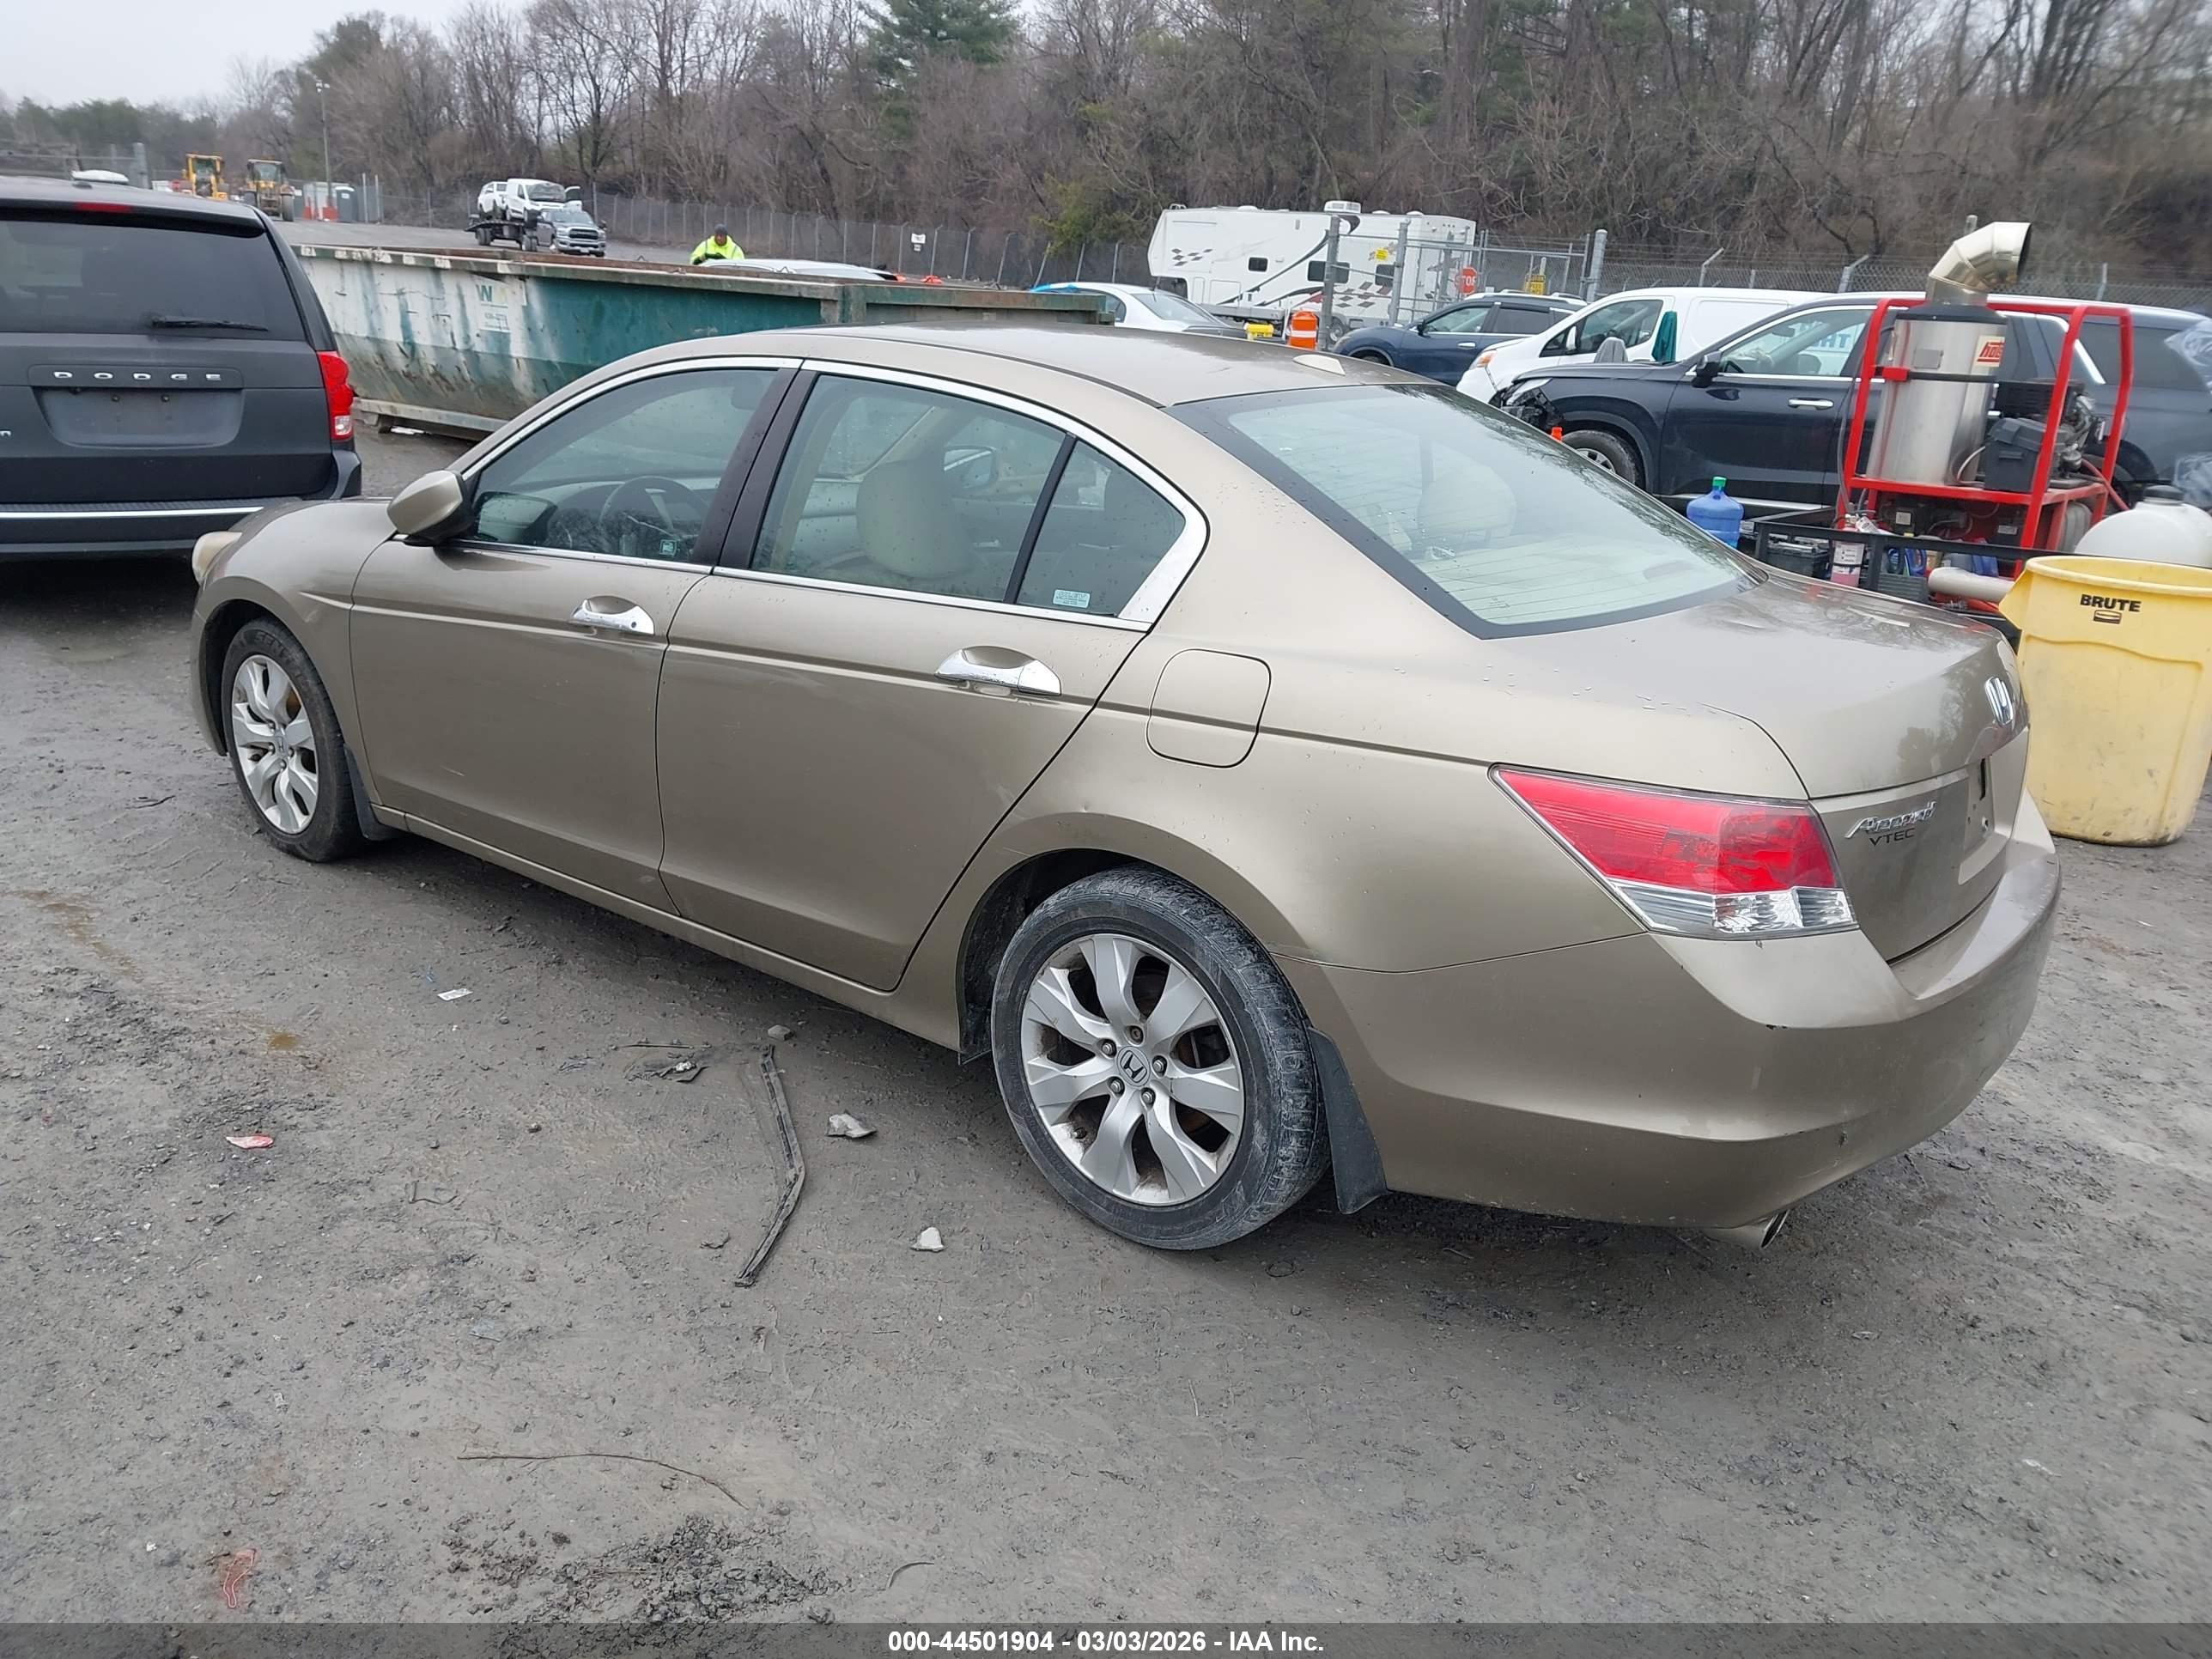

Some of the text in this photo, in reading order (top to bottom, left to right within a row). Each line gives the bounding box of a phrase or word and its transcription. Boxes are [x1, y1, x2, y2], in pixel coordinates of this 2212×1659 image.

[52, 371, 222, 381] DODGE
[2080, 593, 2142, 612] BRUTE
[1844, 800, 1937, 839] Accord
[1869, 827, 1916, 847] VTEC
